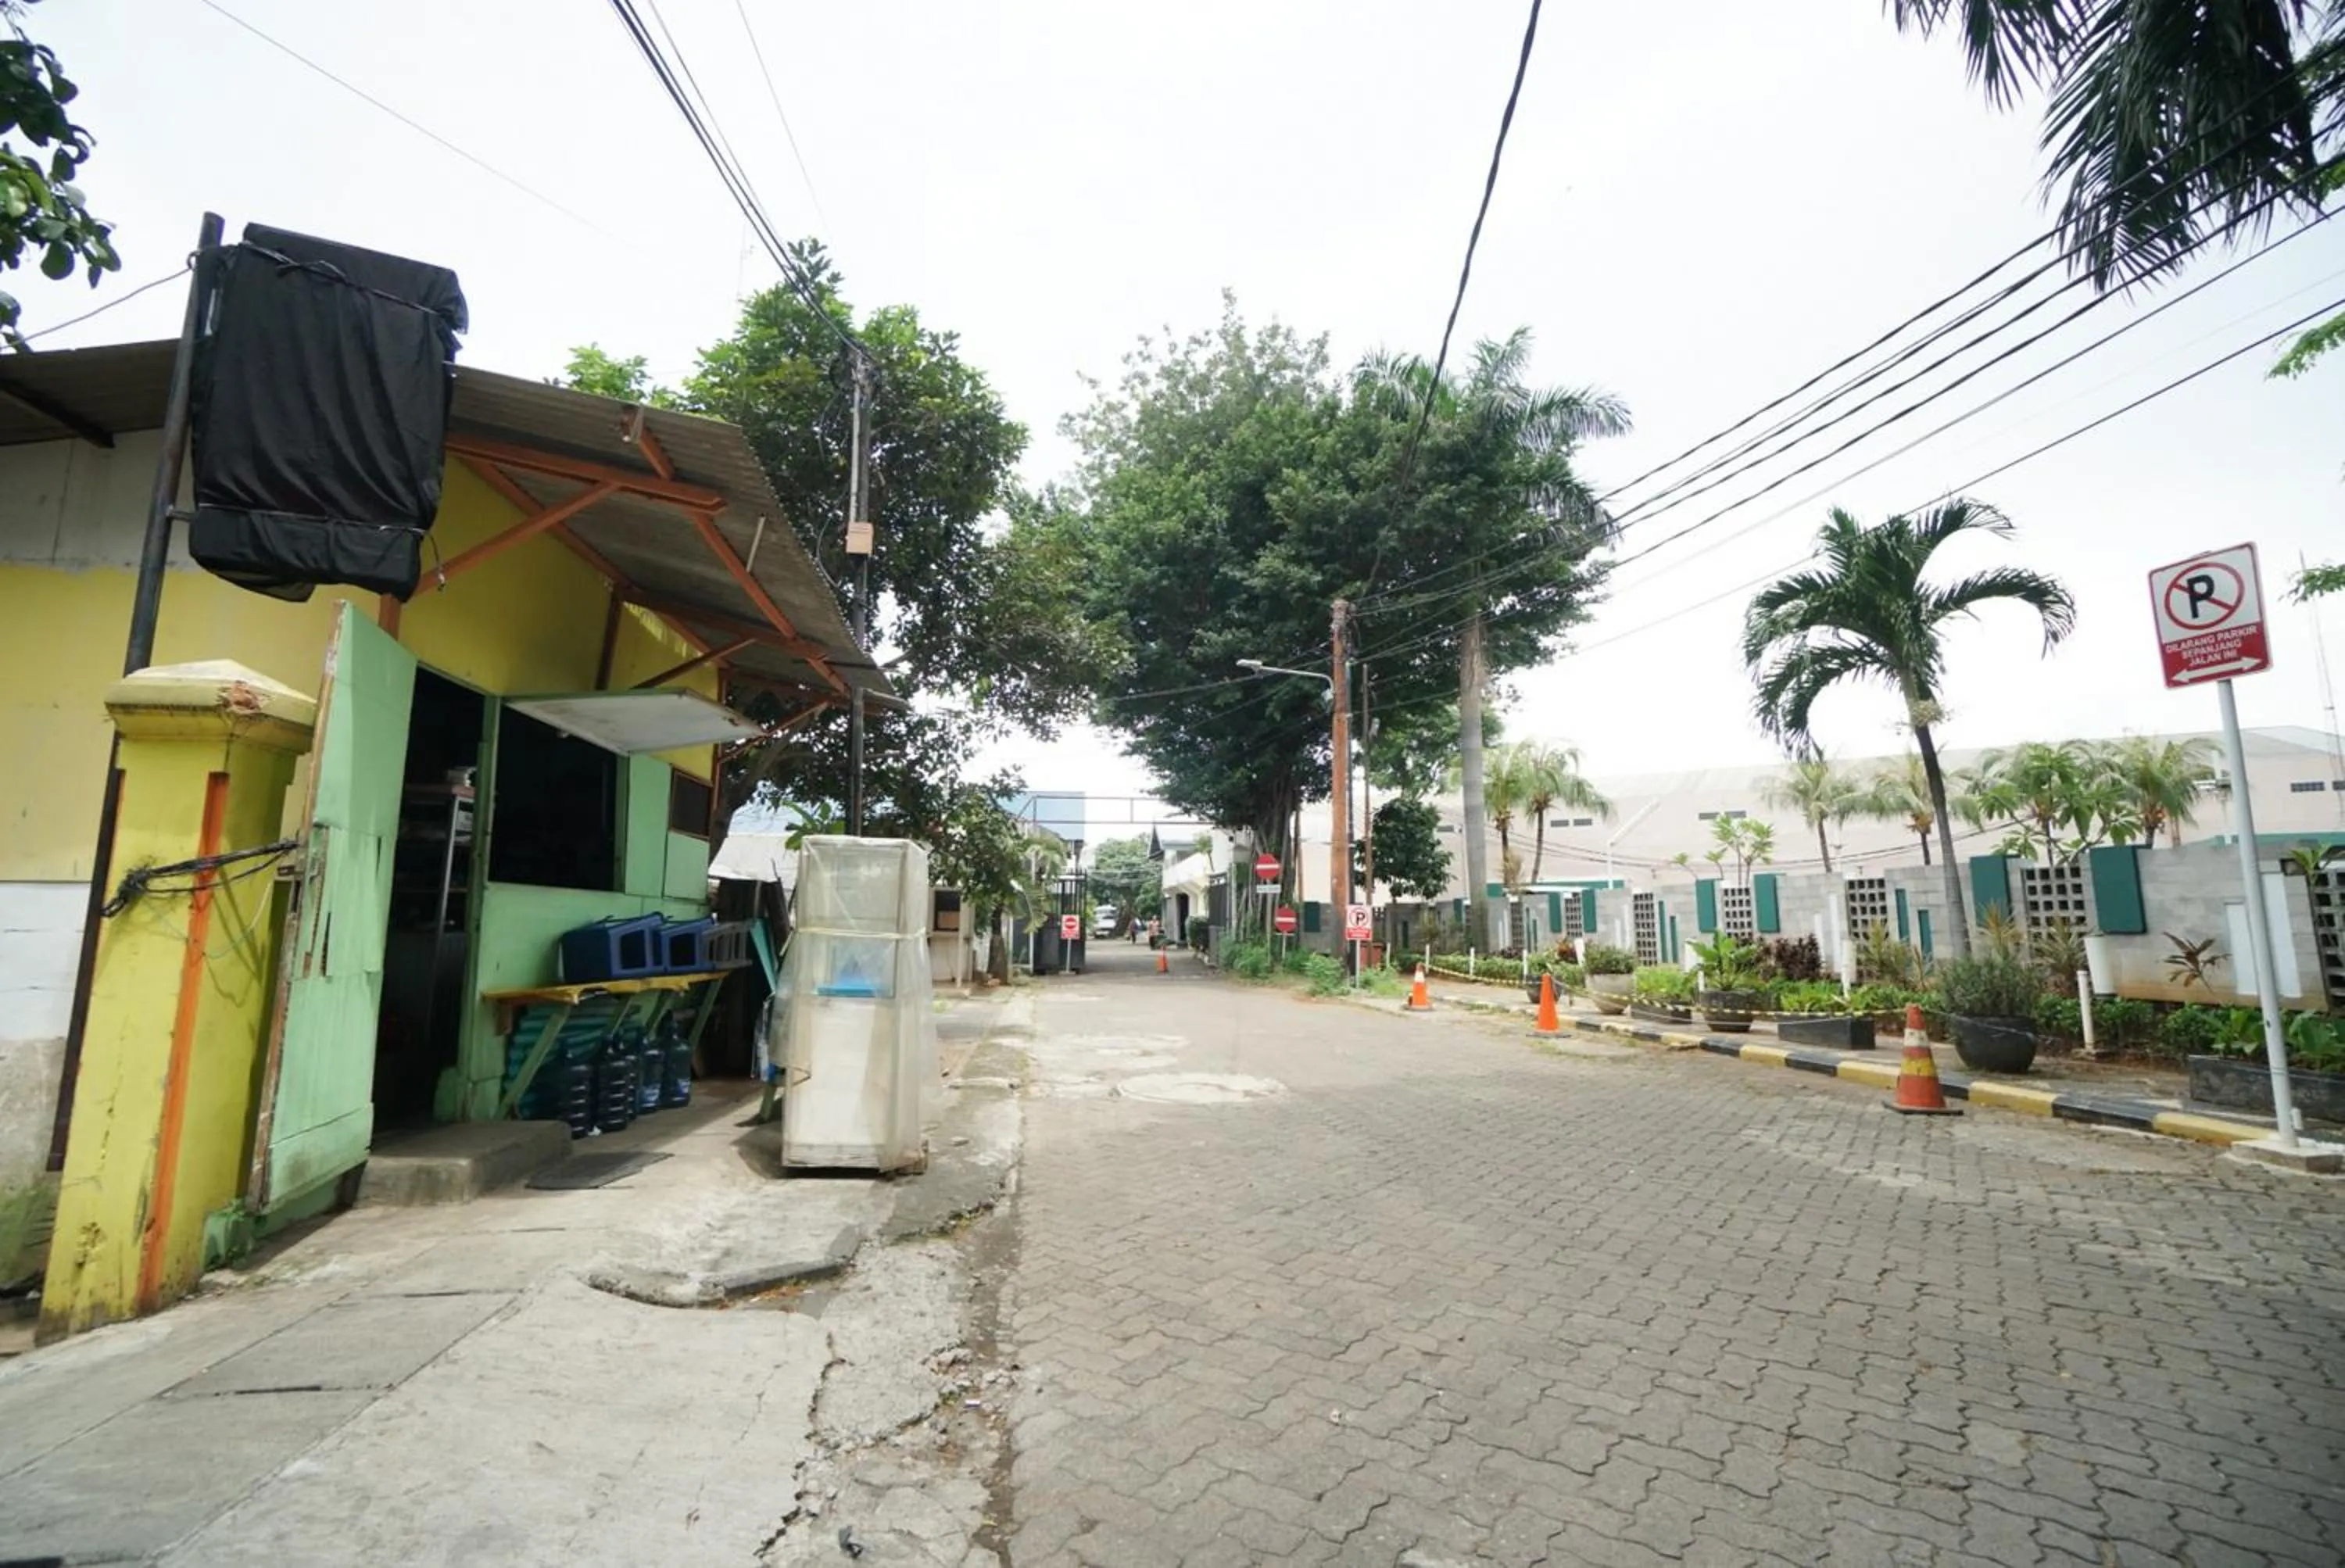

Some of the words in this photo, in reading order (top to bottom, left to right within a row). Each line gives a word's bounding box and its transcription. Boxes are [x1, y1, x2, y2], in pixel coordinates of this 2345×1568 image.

[2187, 575, 2214, 618] P
[2166, 635, 2214, 653] DILARANG
[2217, 626, 2257, 641] PARKIR
[2182, 639, 2242, 659] SEPANJANG
[2189, 653, 2221, 667] JALAN
[2223, 649, 2237, 659] INI
[1356, 912, 1365, 925] P
